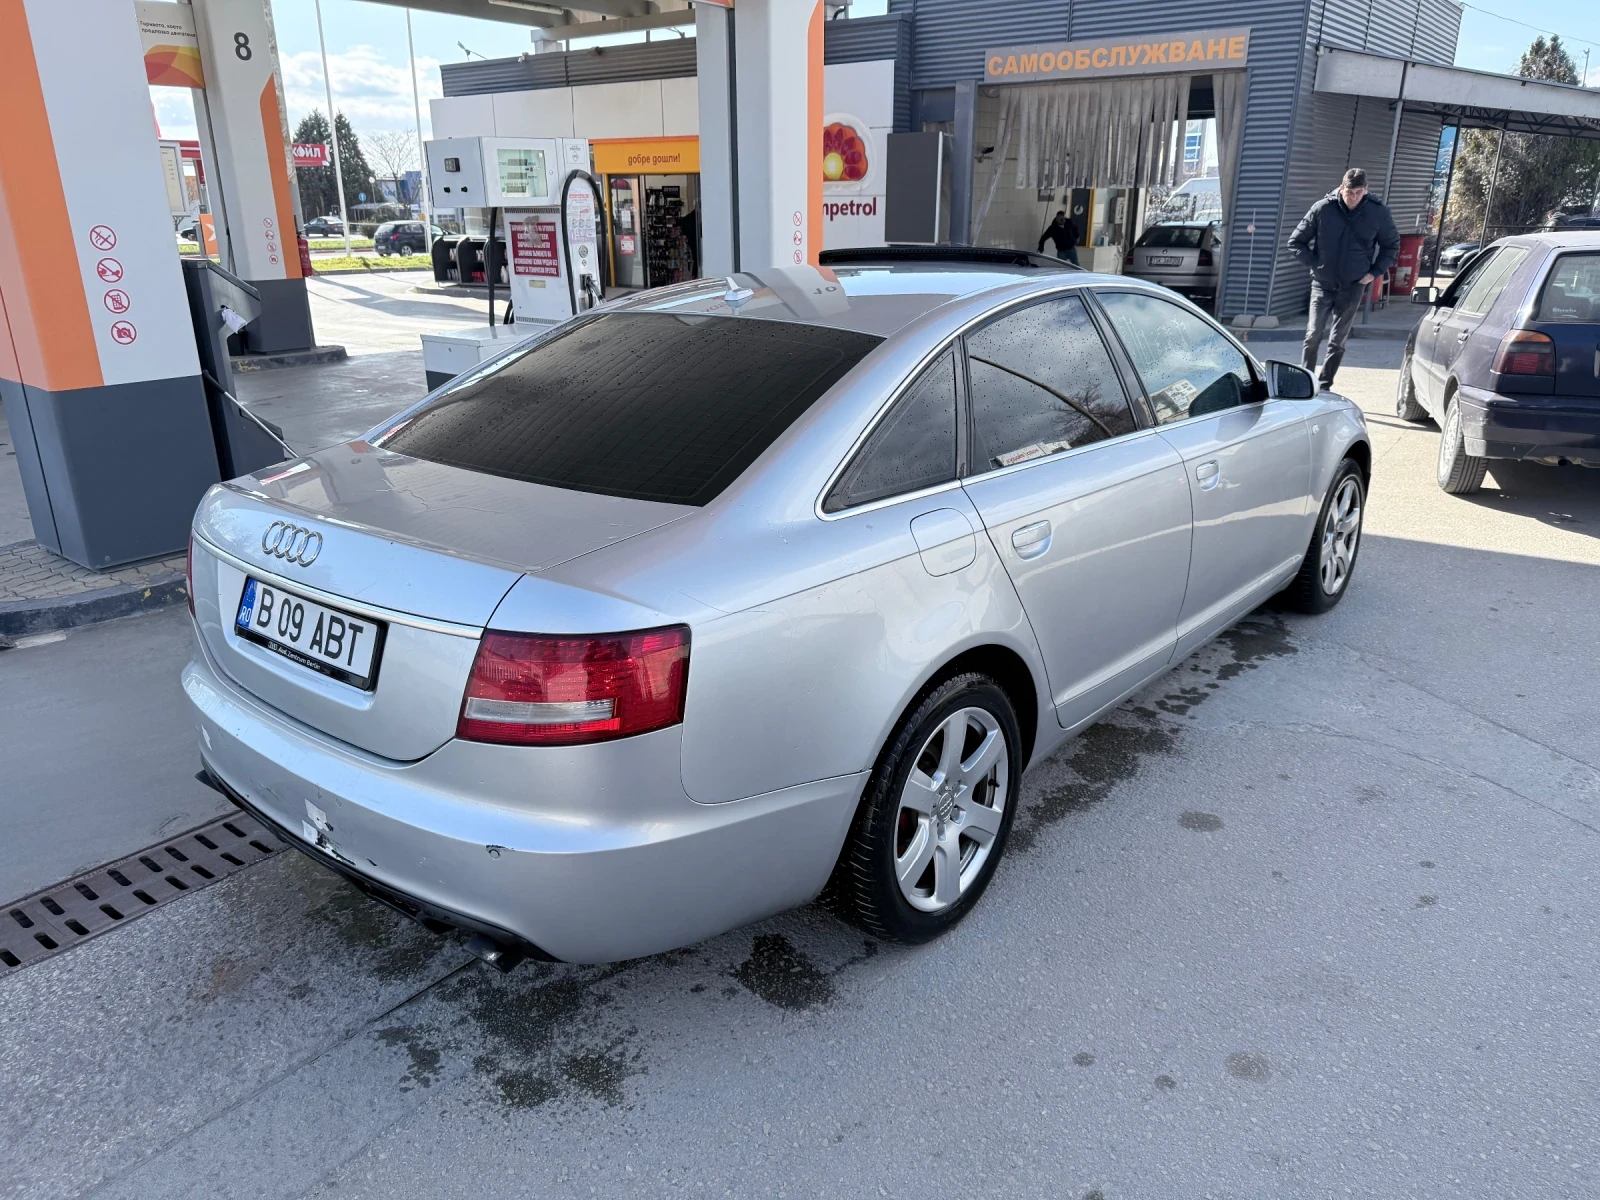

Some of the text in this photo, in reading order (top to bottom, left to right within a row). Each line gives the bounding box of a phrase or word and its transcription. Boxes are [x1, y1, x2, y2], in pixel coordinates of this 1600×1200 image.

[233, 31, 253, 61] 8
[987, 36, 1247, 77] САМООБСЛУЖВАНЕ
[627, 153, 681, 166] добре дошли!
[239, 587, 364, 667] RO B 09 ABT
[306, 659, 321, 670] Berlin
